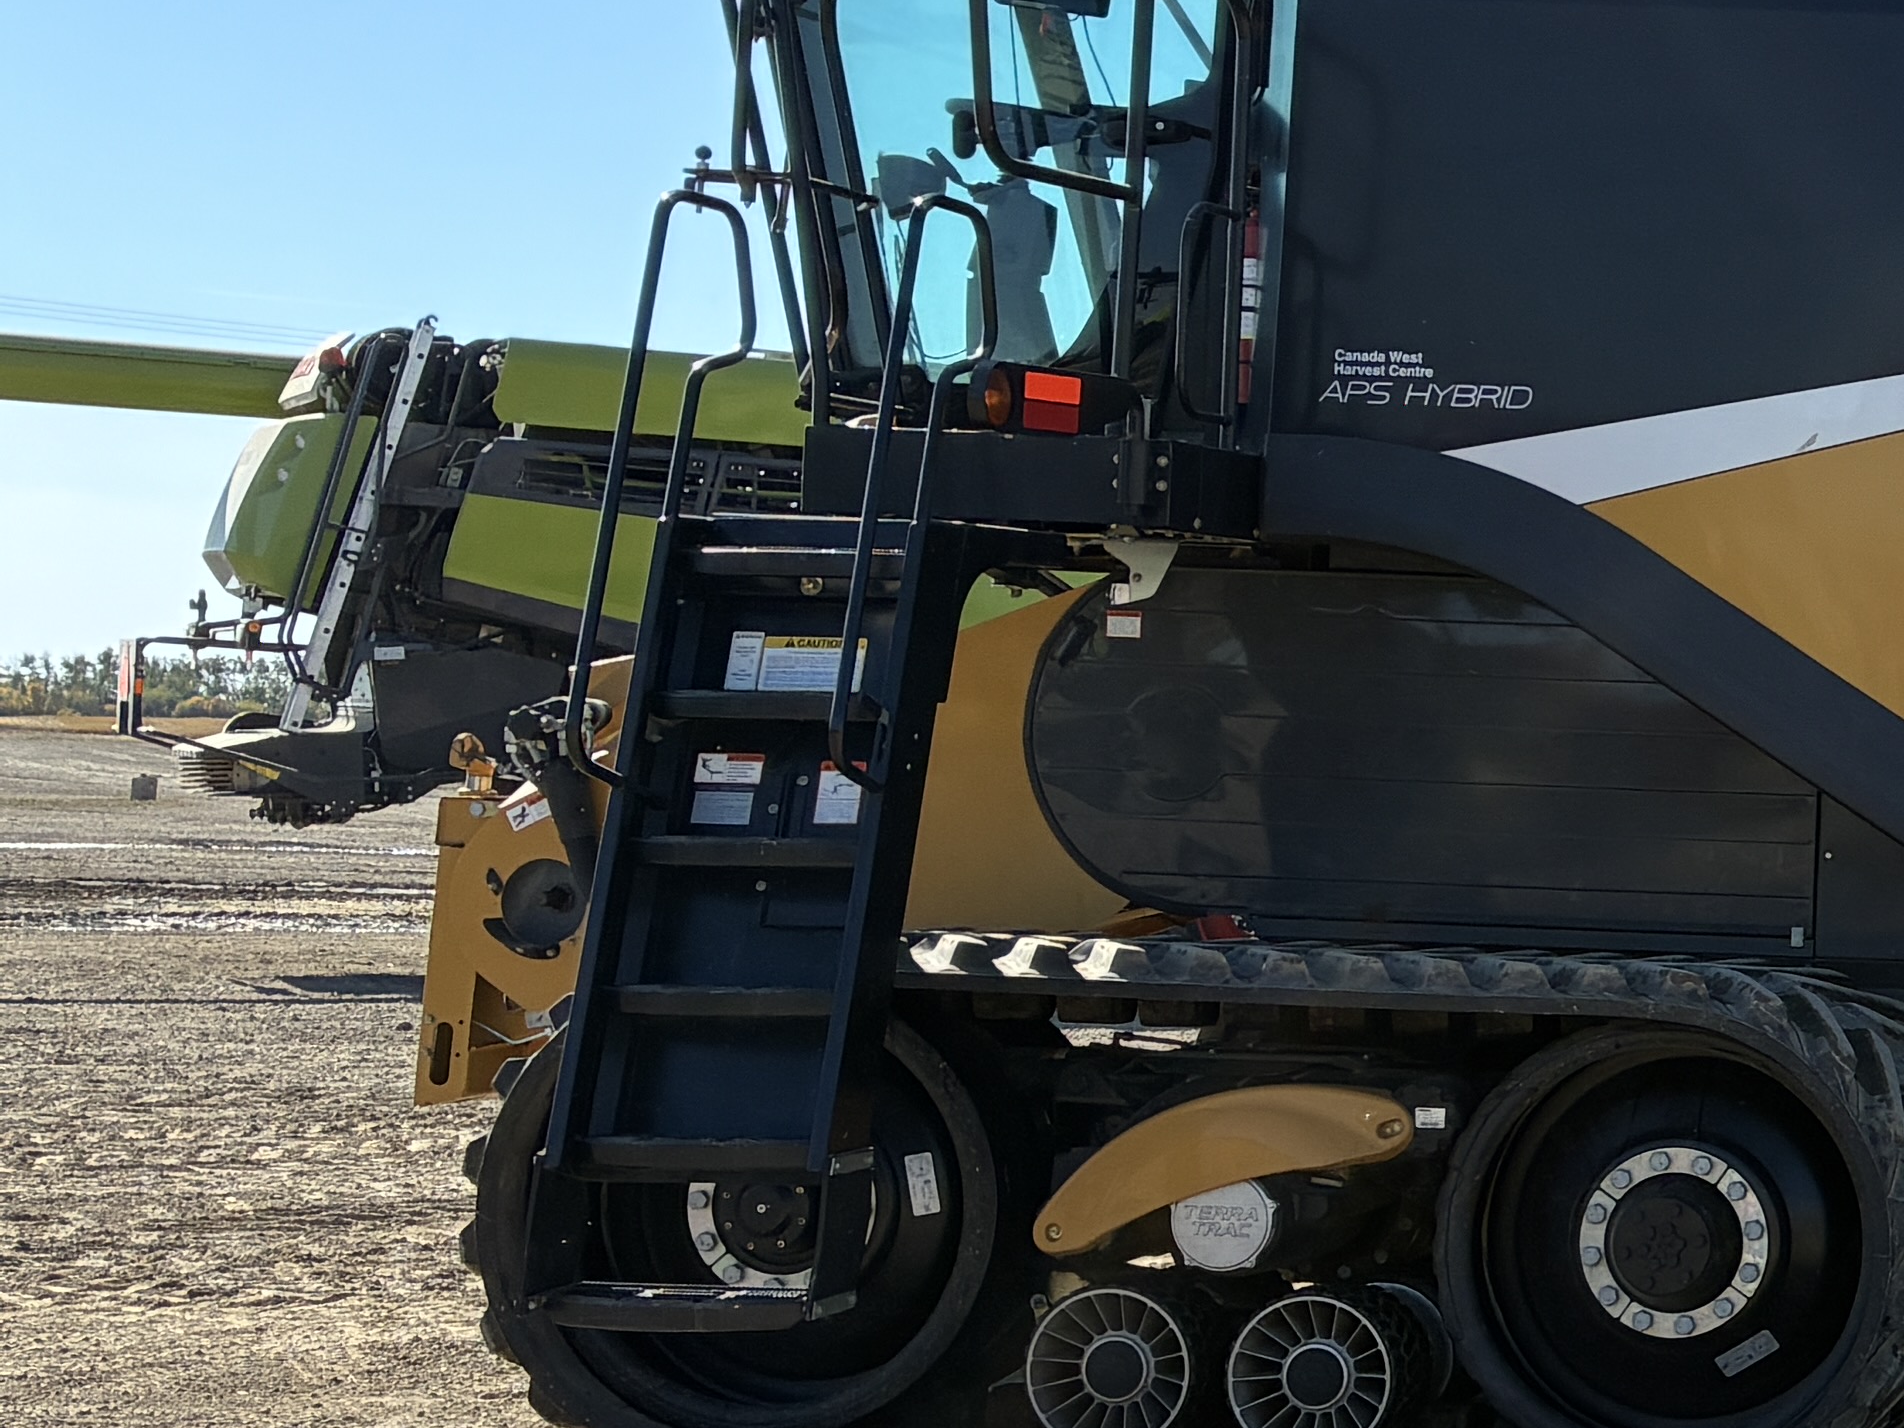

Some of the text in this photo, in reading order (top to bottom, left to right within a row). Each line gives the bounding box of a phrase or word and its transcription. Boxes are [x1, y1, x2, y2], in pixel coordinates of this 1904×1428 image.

[1334, 349, 1423, 364] Canada West
[1334, 363, 1434, 378] Harvest Centre
[1319, 380, 1533, 409] APS HYBRID
[1184, 1204, 1259, 1222] TERRA
[1192, 1220, 1252, 1238] TRAC
